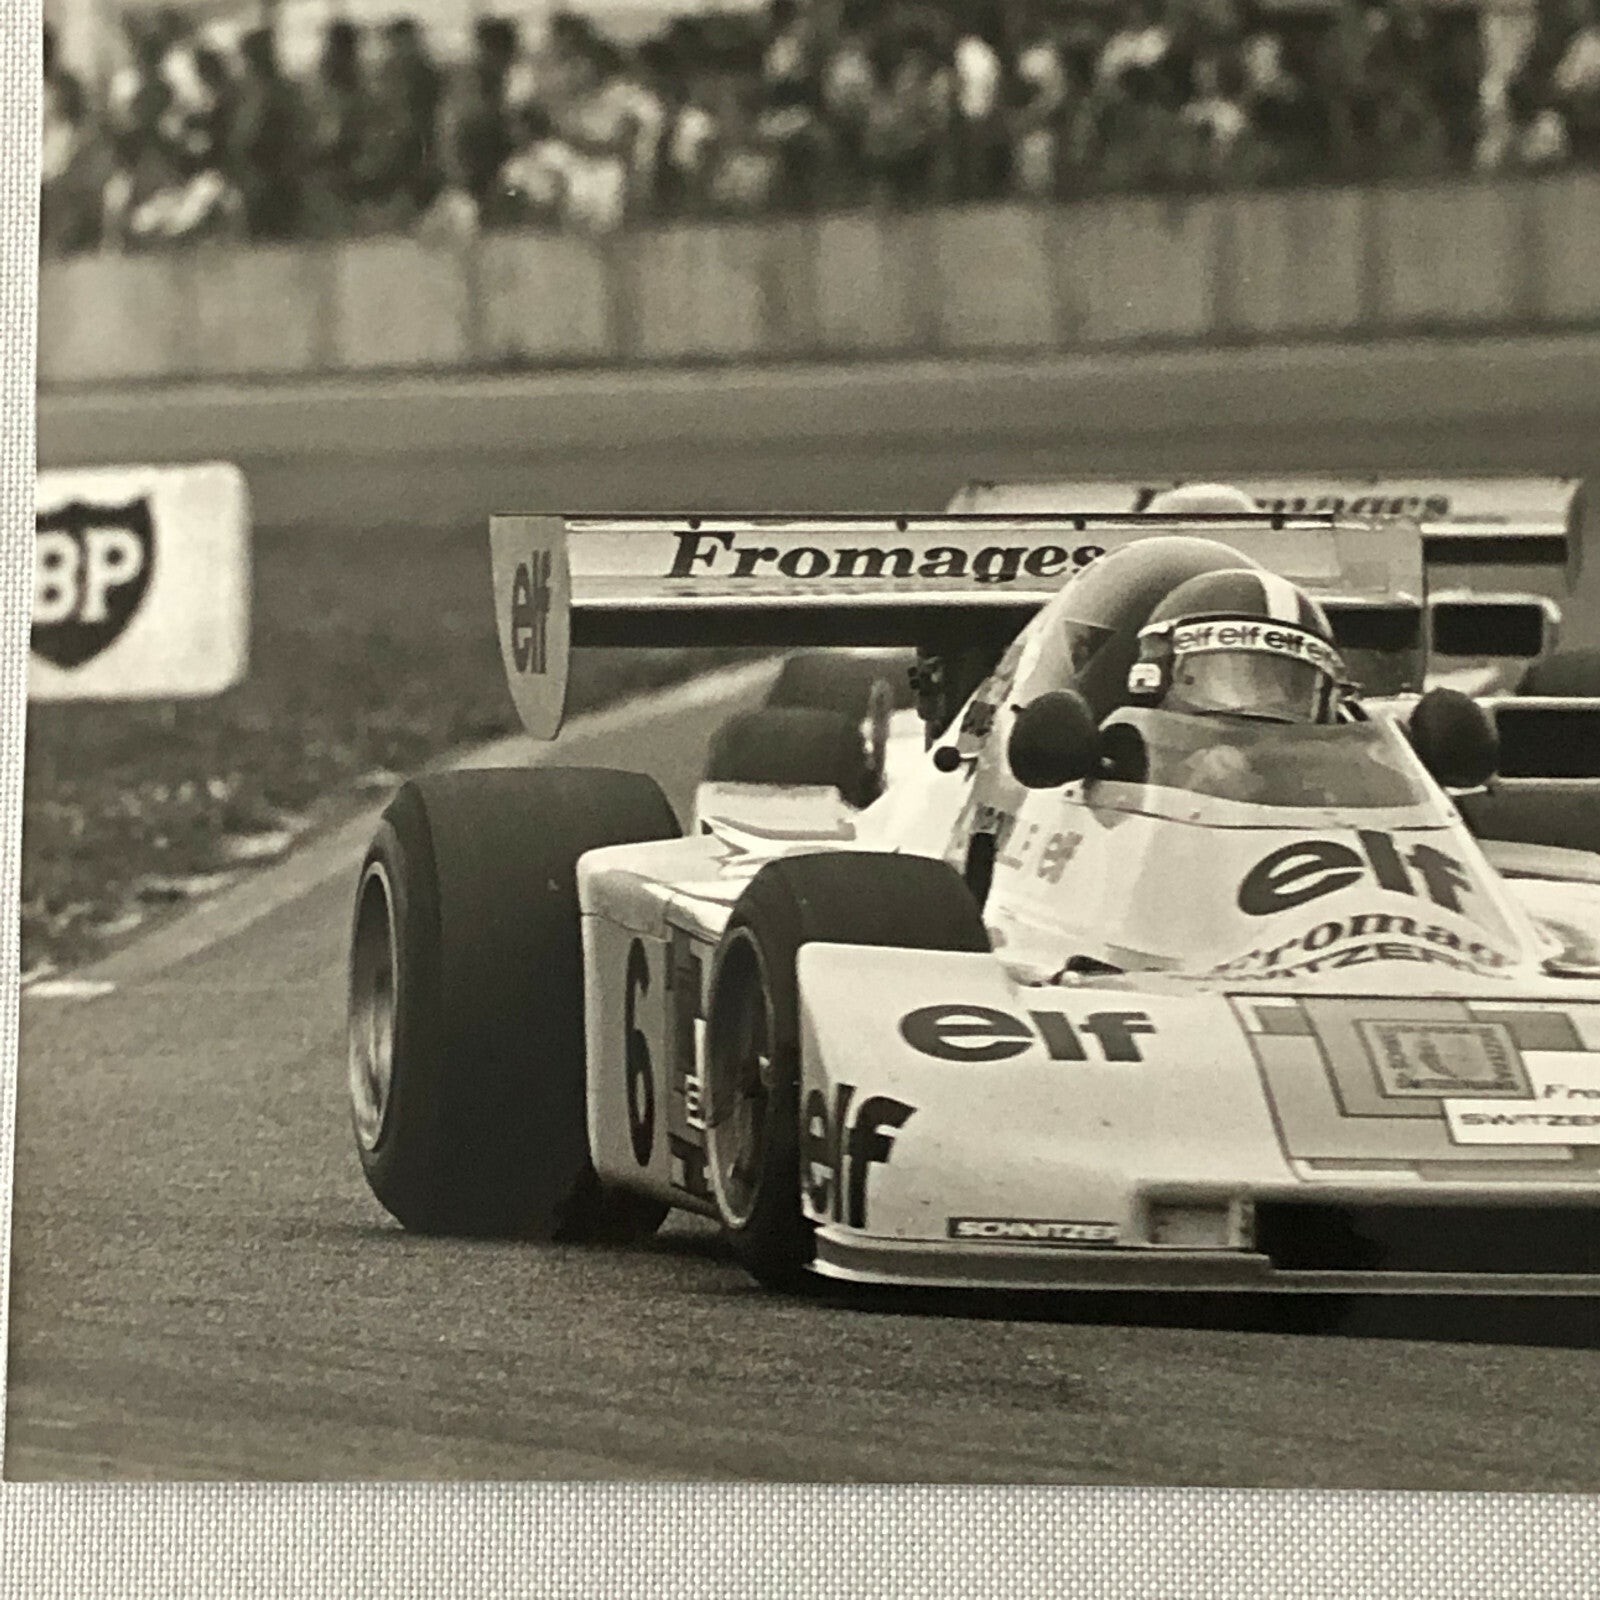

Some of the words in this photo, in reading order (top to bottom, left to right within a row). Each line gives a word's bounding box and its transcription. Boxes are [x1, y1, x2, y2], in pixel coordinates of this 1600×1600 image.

[34, 527, 144, 622] BP
[1236, 828, 1475, 916] elf
[625, 937, 655, 1167] 6
[898, 1003, 1157, 1063] elf
